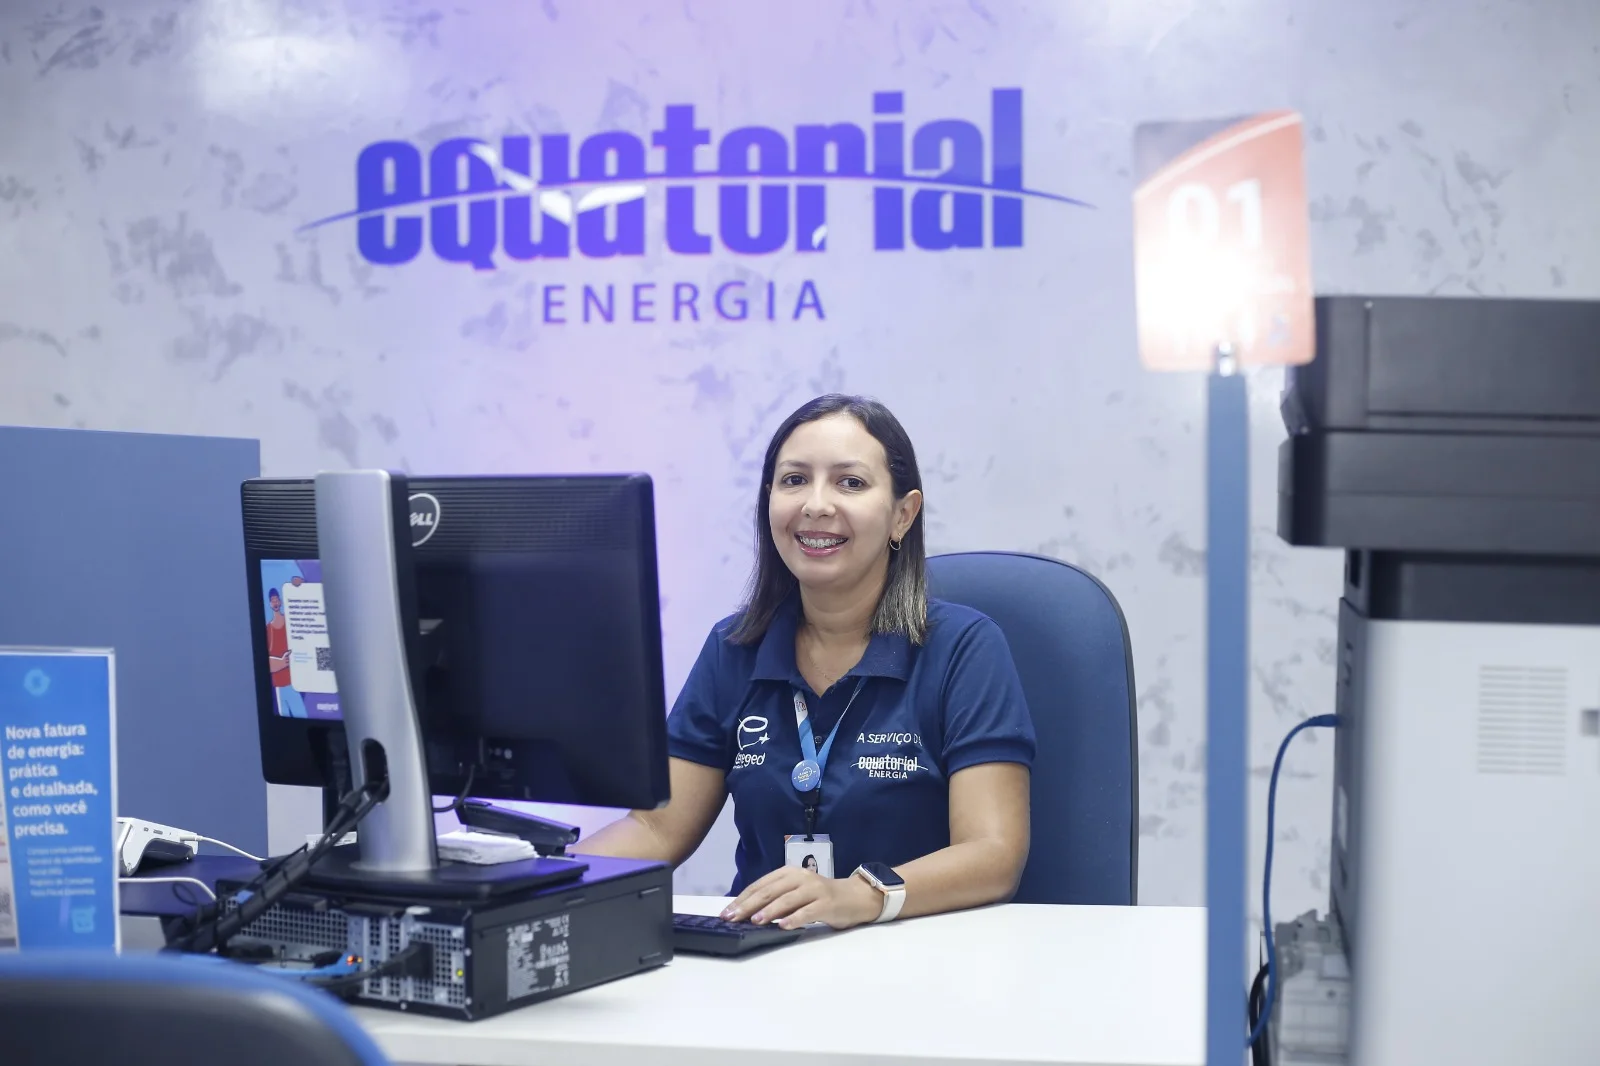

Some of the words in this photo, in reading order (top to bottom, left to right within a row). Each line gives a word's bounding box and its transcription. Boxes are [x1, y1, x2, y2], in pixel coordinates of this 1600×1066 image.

[356, 88, 1024, 270] equatorial
[1166, 179, 1263, 257] 01
[543, 279, 827, 324] ENERGIA
[409, 511, 434, 527] ELL
[5, 726, 41, 740] Nova
[44, 722, 87, 738] fatura
[856, 732, 865, 744] A
[867, 732, 912, 746] SERVIÇO
[7, 745, 25, 759] de
[28, 741, 84, 759] energia:
[858, 754, 918, 771] equatorial
[9, 763, 58, 781] prática
[868, 770, 908, 779] ENERGIA
[11, 786, 20, 798] e
[23, 780, 98, 797] detalhada,
[13, 804, 52, 817] como
[54, 799, 87, 815] você
[14, 821, 68, 839] precisa.
